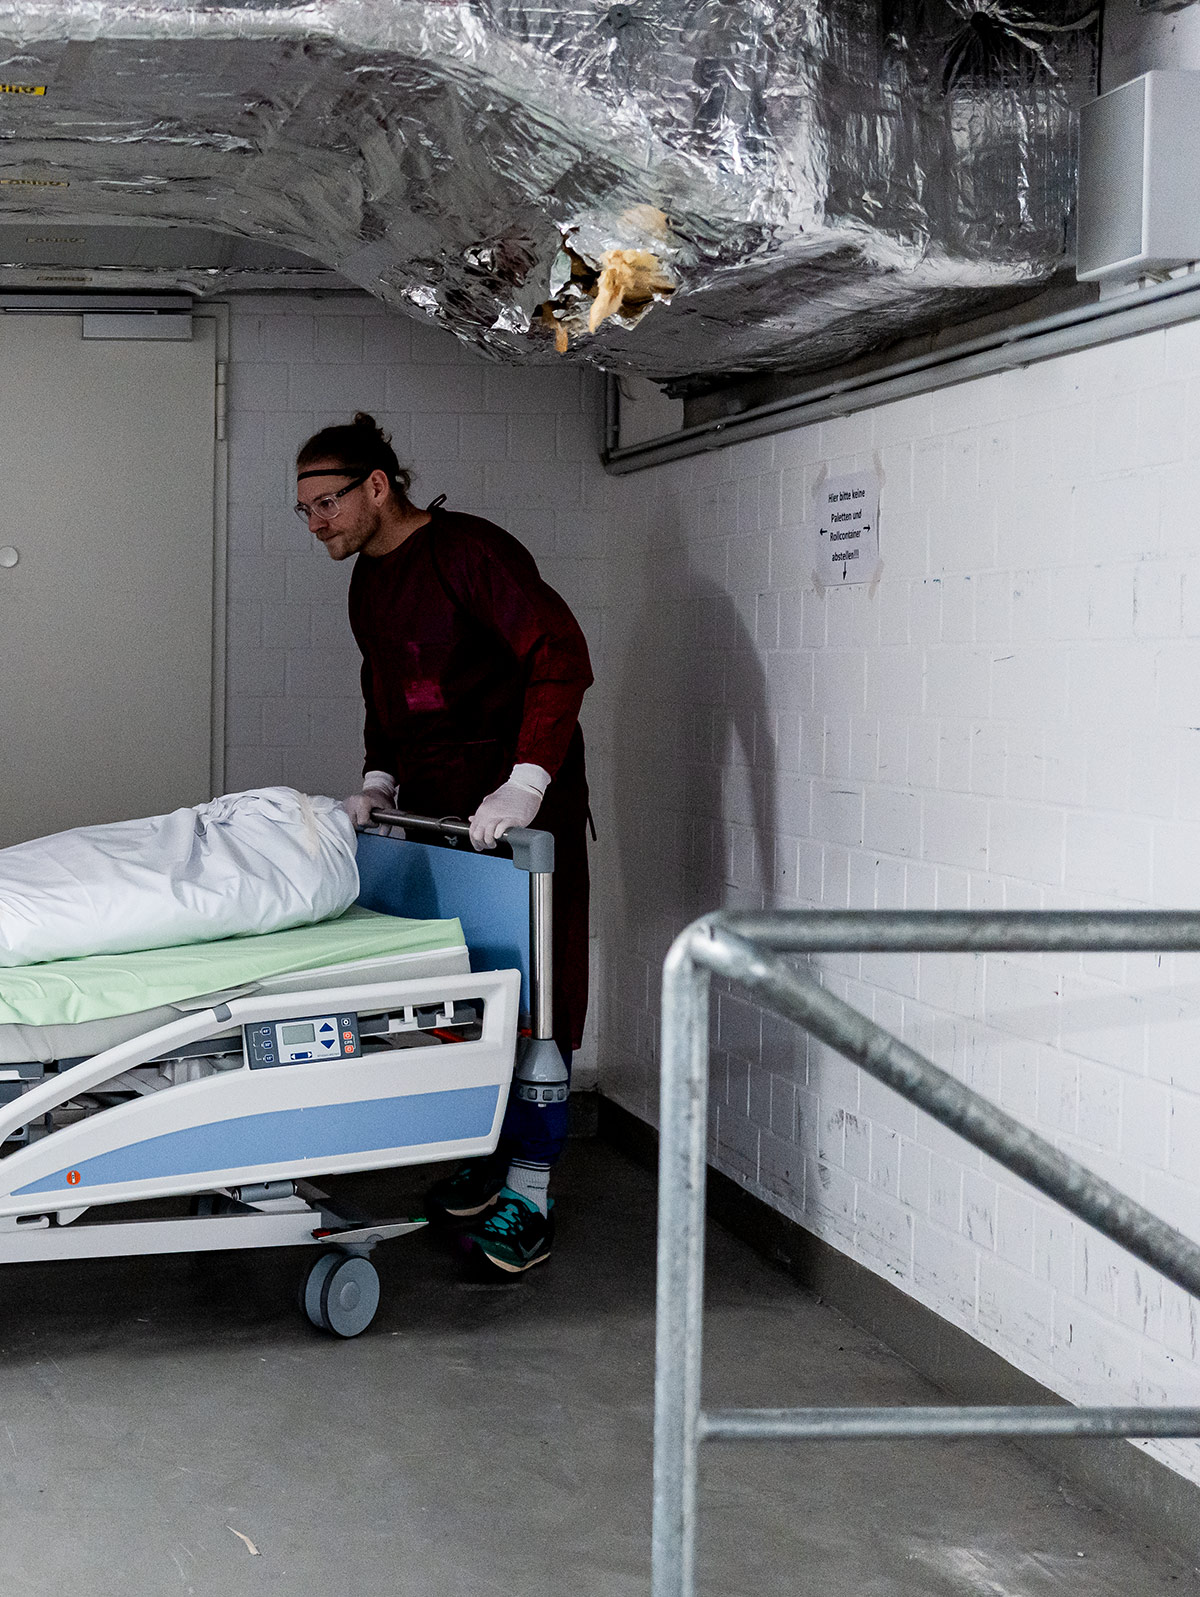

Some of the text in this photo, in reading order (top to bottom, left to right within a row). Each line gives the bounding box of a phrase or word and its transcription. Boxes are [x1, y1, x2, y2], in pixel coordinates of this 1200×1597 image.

[828, 488, 865, 503] Hier bitte keine
[831, 509, 862, 523] Paletten und
[830, 529, 861, 541] Rollcontainer
